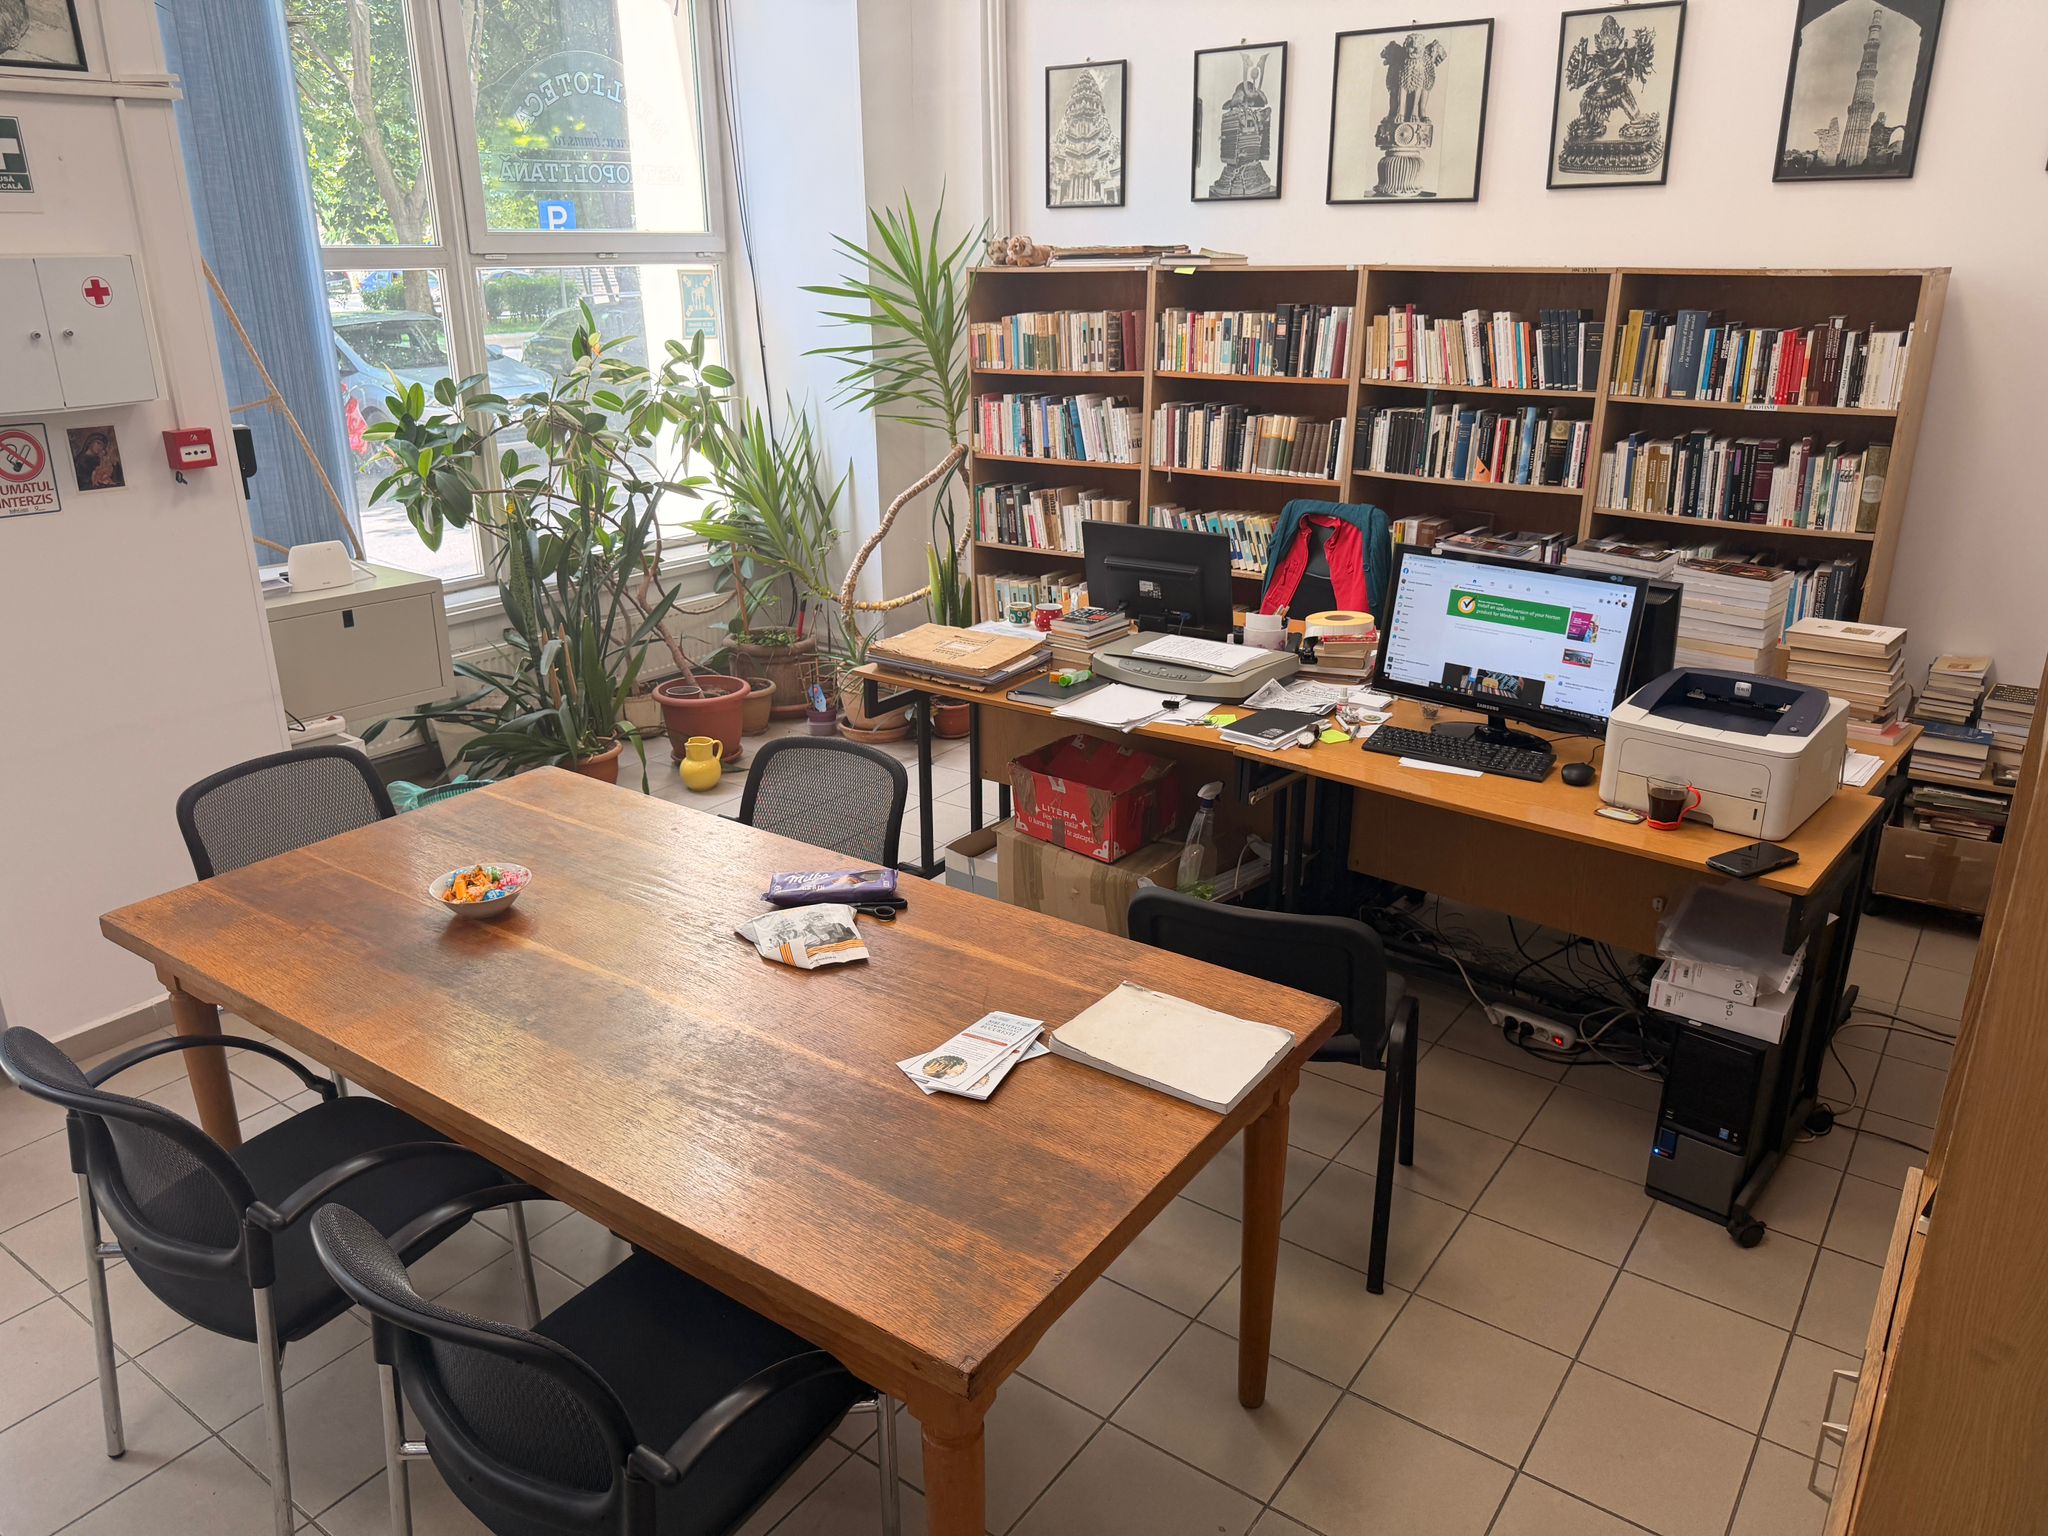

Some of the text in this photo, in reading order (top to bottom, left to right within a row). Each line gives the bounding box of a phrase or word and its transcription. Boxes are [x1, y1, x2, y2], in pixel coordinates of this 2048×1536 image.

[0, 182, 24, 190] CALĂ
[547, 205, 568, 230] P
[1041, 803, 1078, 821] LITERA
[784, 872, 832, 885] Milka
